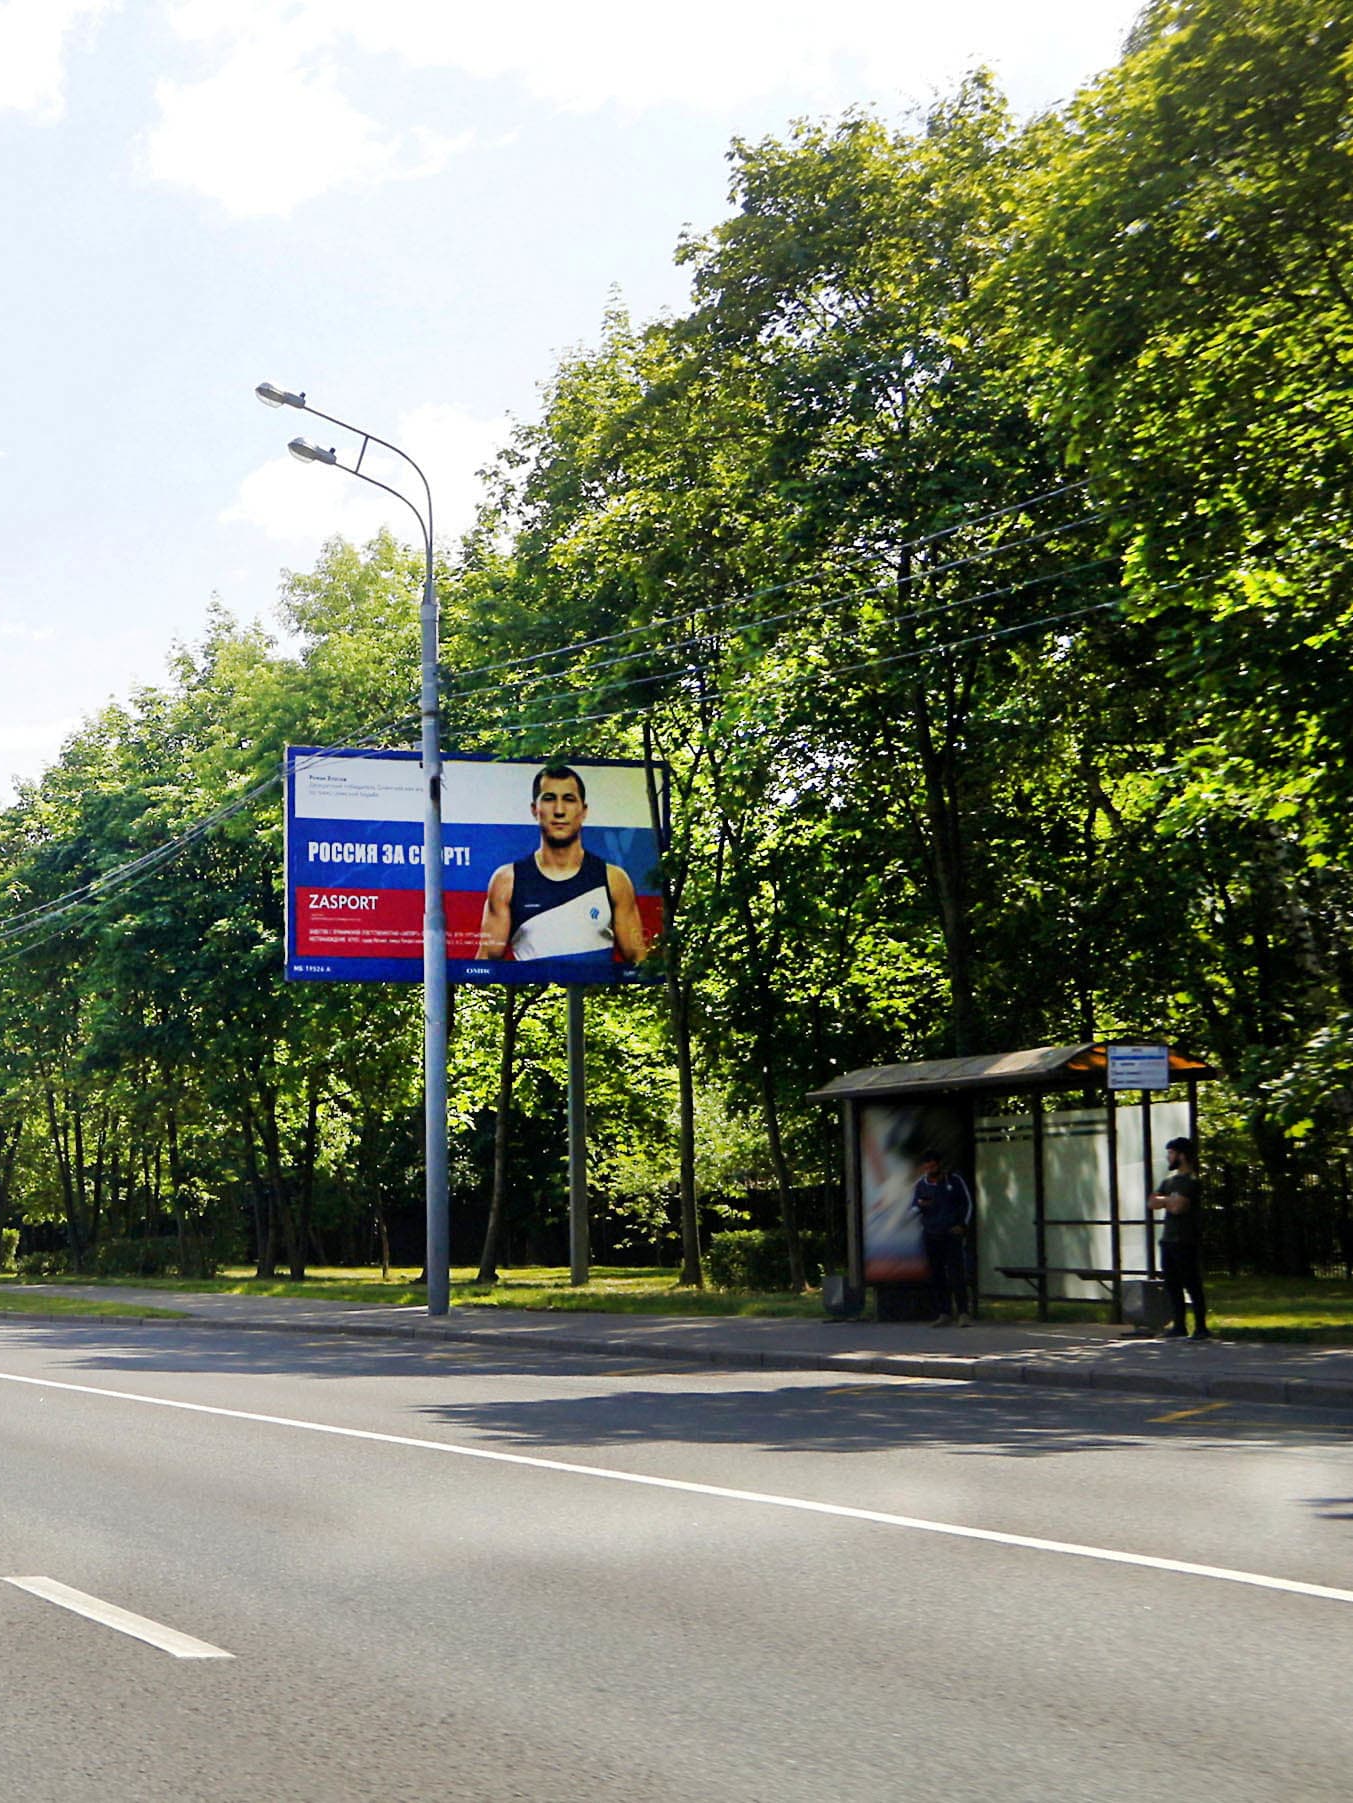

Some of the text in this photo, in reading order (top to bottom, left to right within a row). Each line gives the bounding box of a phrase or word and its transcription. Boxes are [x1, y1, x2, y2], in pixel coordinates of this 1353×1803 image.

[308, 841, 471, 866] РОССИЯ ЗА СРТ!
[309, 894, 379, 910] ZASPORT
